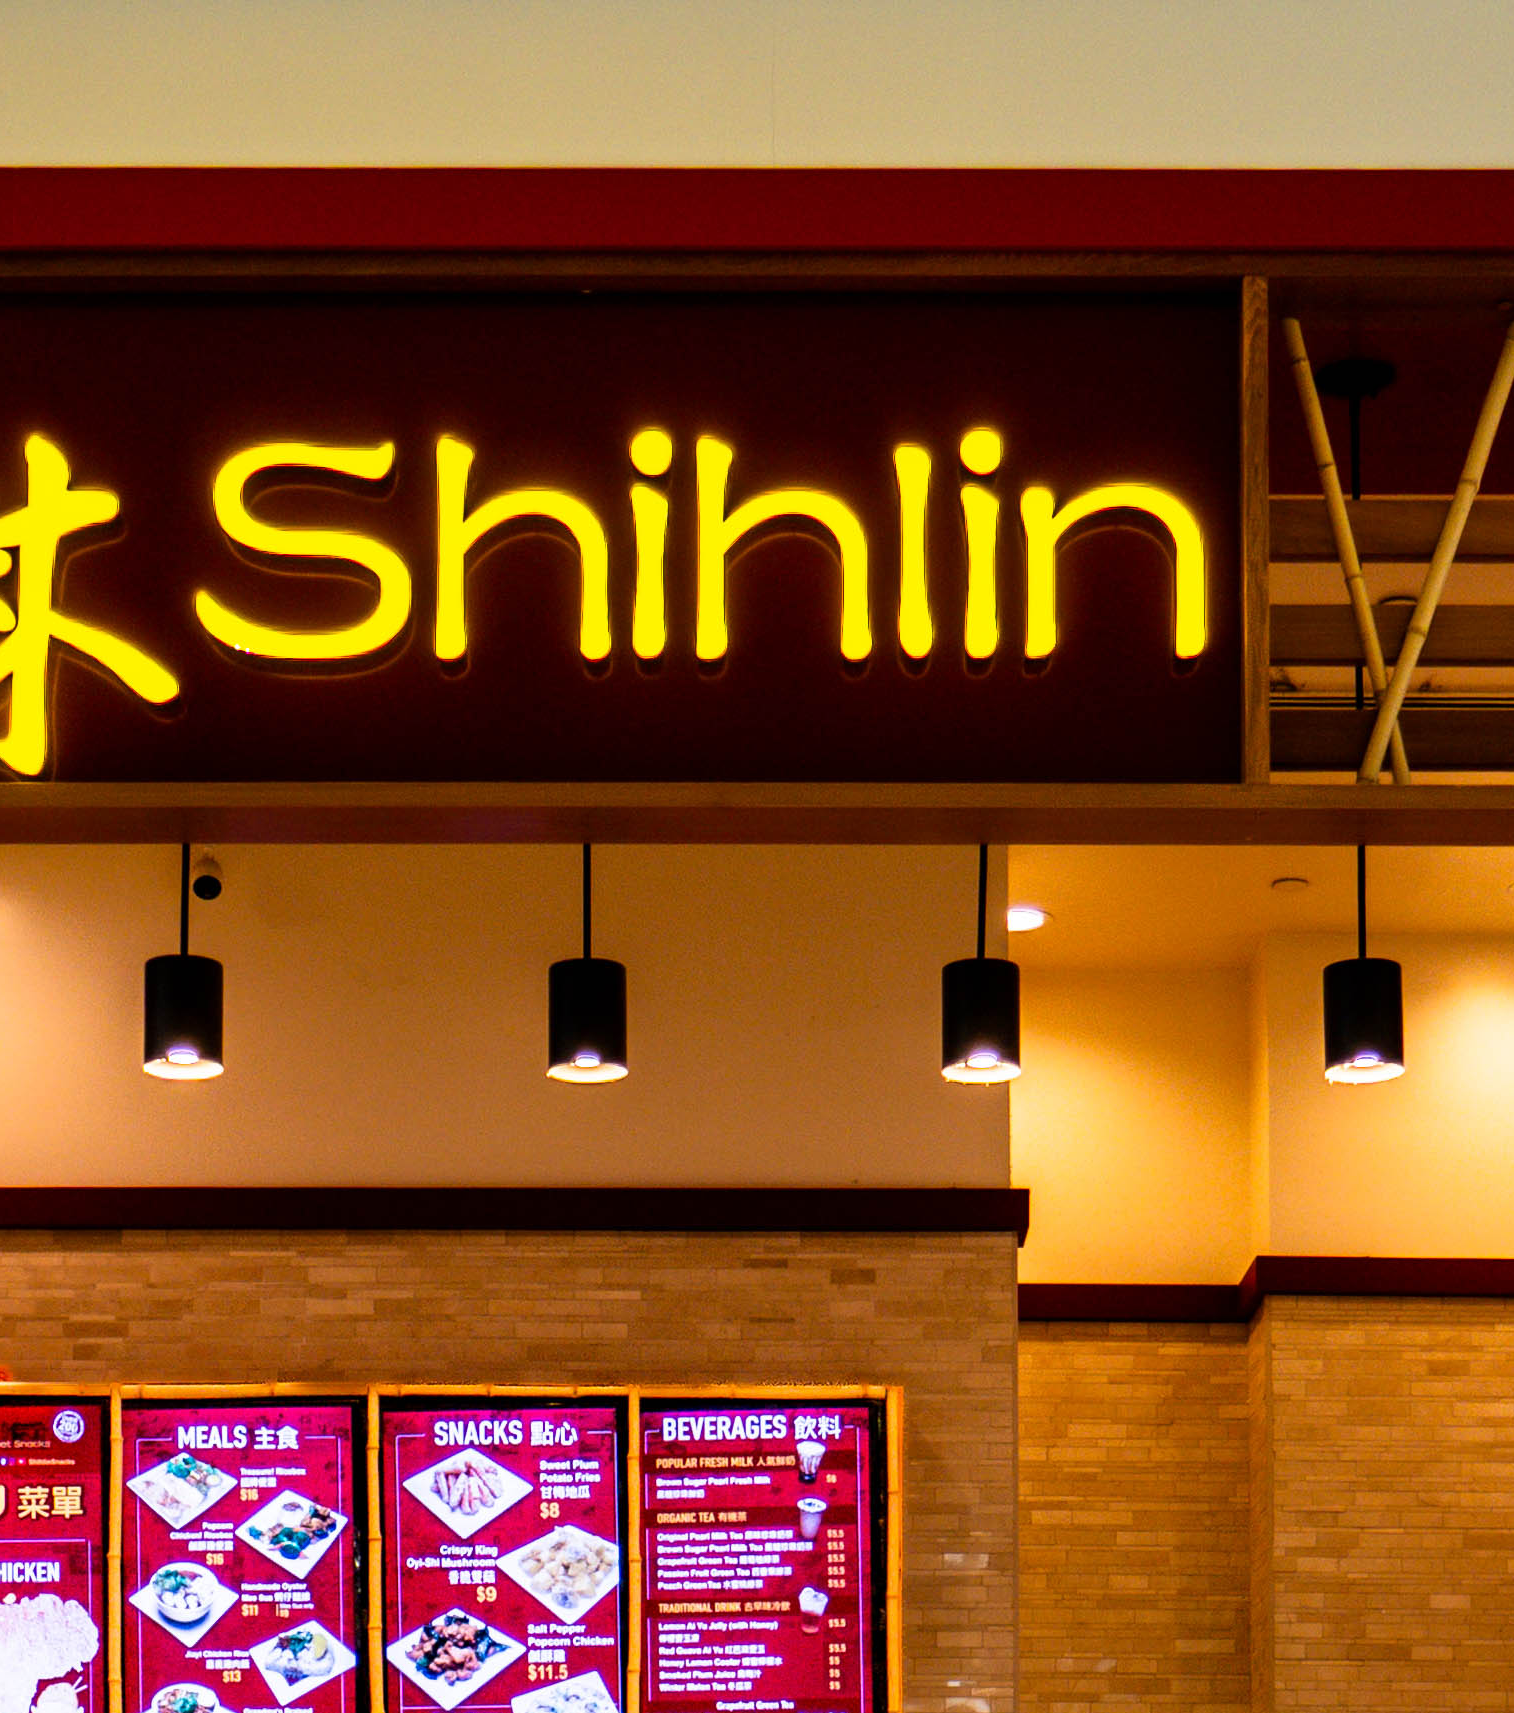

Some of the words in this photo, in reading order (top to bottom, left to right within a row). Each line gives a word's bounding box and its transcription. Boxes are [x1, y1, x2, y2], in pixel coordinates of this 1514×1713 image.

[195, 424, 1209, 661] Shihlin
[434, 1420, 523, 1446] SNACKS
[530, 1421, 578, 1446] 點心
[663, 1415, 786, 1441] BEVERAGES
[794, 1415, 841, 1440] 飲料
[178, 1425, 247, 1449] MEALS
[253, 1425, 299, 1450] 主食
[539, 1460, 570, 1470] Sweet
[573, 1460, 599, 1470] Plum
[656, 1457, 697, 1468] POPULAR
[699, 1457, 729, 1468] FRESH
[731, 1457, 754, 1467] MILK
[540, 1473, 573, 1483] Potato
[575, 1472, 601, 1483] Fries
[240, 1489, 258, 1501] $16
[17, 1486, 83, 1519] 菜單
[540, 1502, 560, 1519] $8
[657, 1513, 696, 1523] ORGANIC
[698, 1512, 715, 1523] TEA
[440, 1545, 473, 1556] Crispy
[475, 1545, 498, 1556] King
[206, 1553, 224, 1565] $16
[441, 1558, 495, 1568] Mushroom
[476, 1586, 497, 1603] $9
[241, 1605, 259, 1617] $11
[715, 1602, 741, 1612] DRINK
[527, 1624, 547, 1634] Salt
[549, 1624, 586, 1635] Pepper
[528, 1637, 570, 1648] Popcorn
[573, 1636, 615, 1646] Chicken
[223, 1670, 241, 1683] $13
[528, 1665, 568, 1681] $11.5
